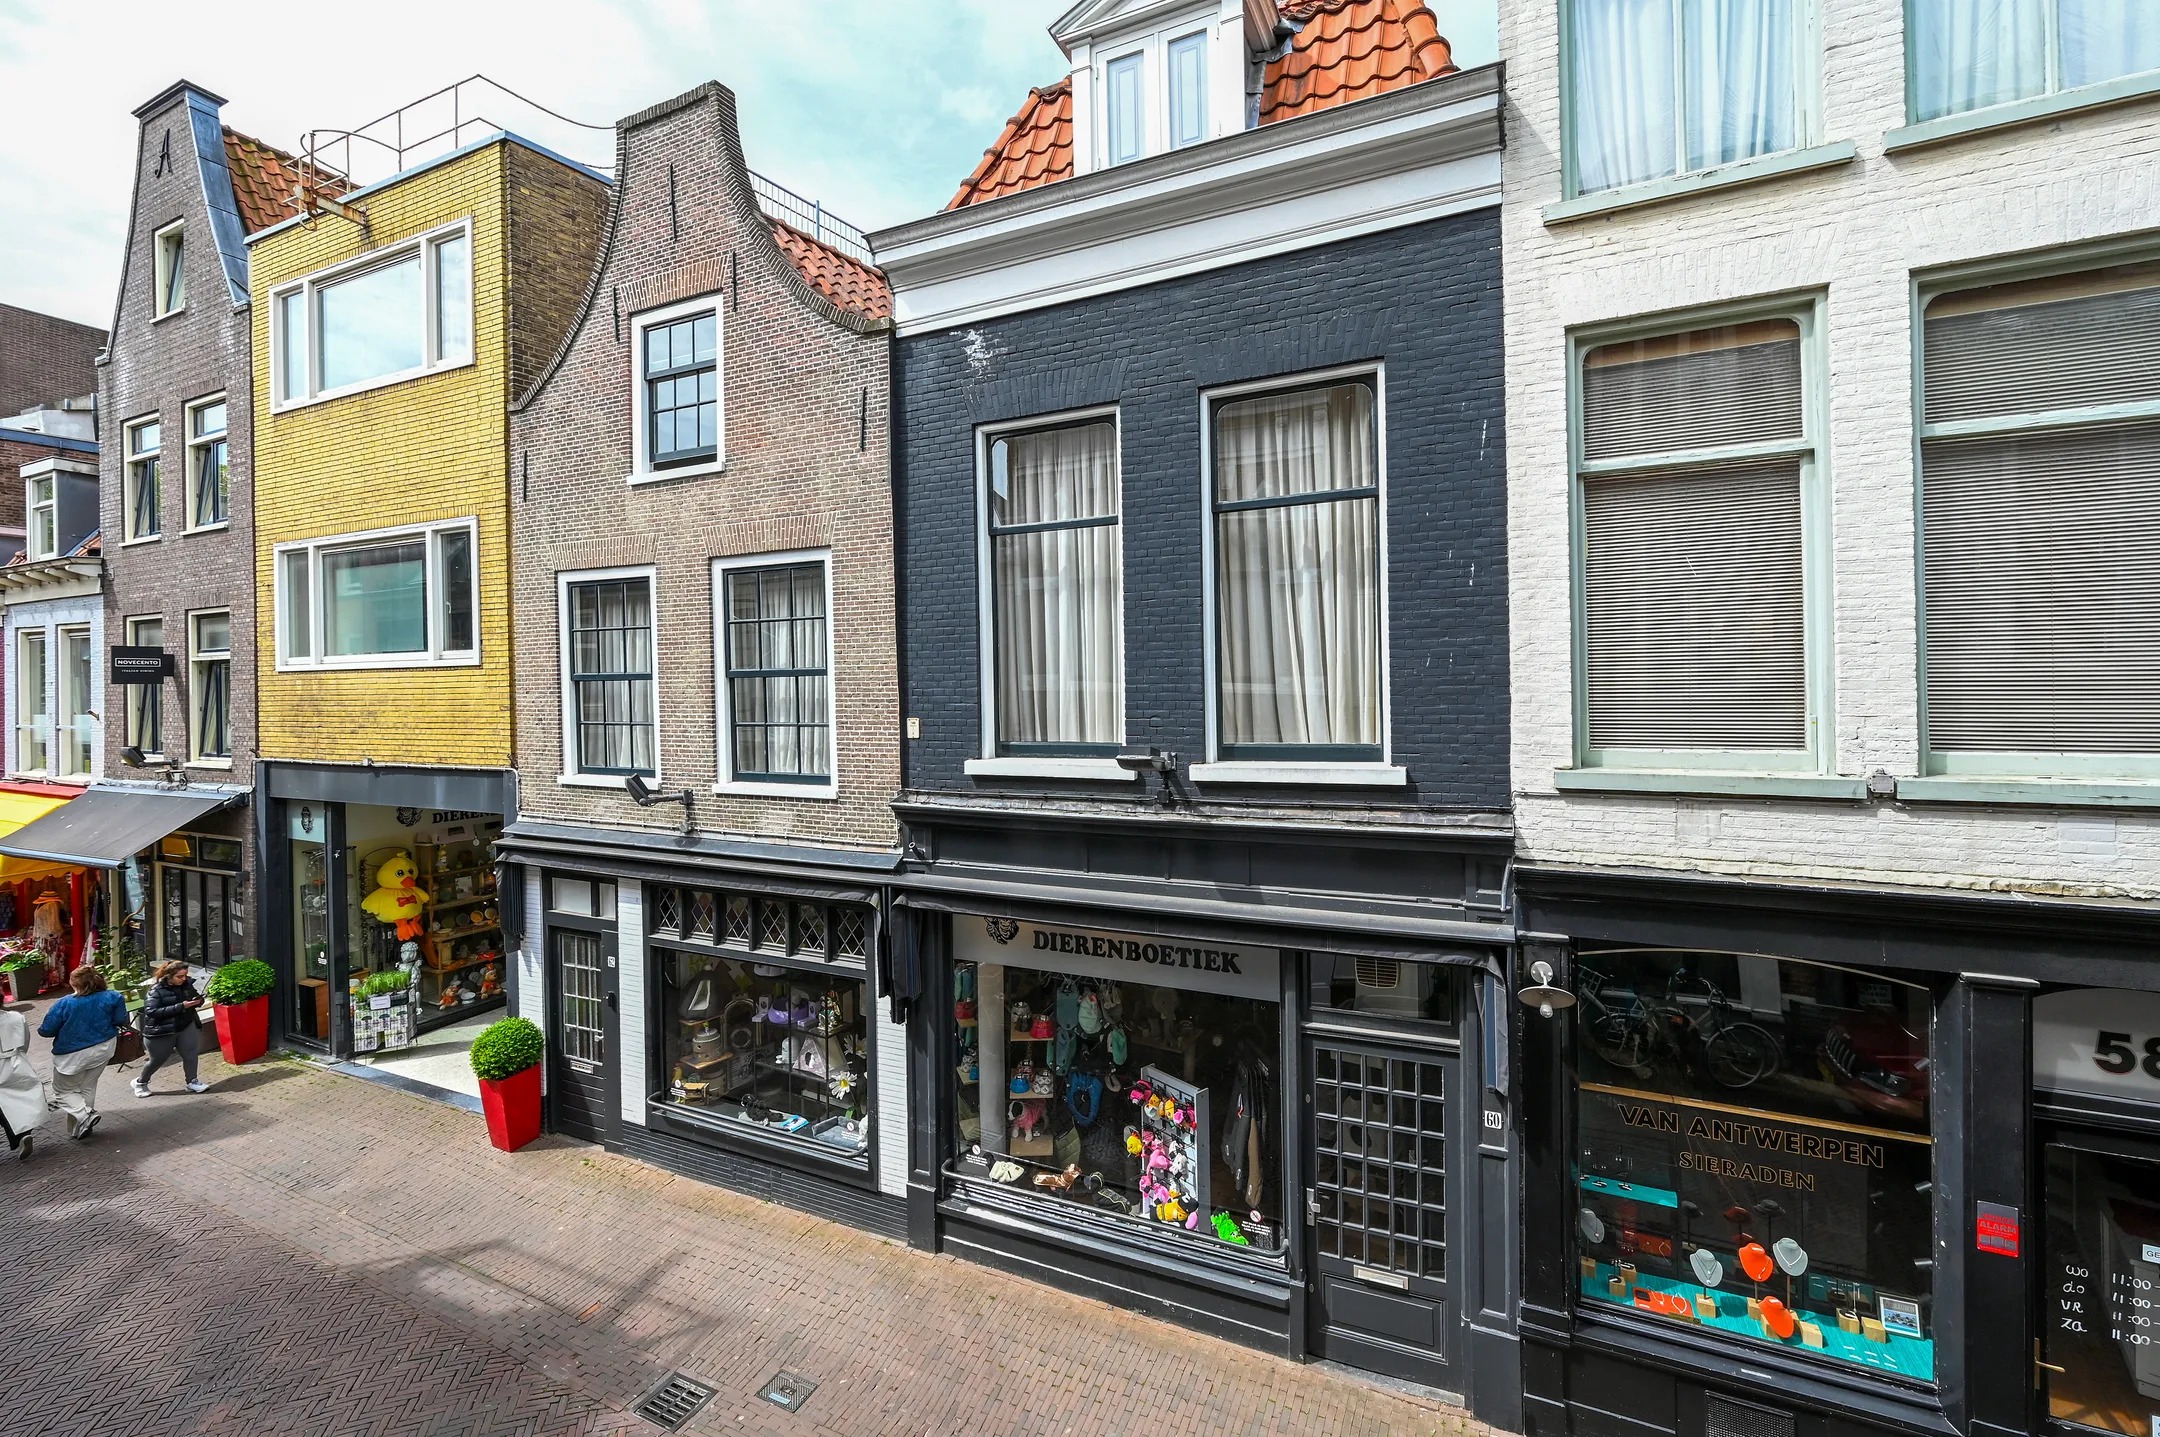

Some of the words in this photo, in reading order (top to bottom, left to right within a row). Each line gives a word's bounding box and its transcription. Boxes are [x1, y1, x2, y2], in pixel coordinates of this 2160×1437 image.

[1033, 930, 1242, 974] DIERENBOETIEK
[1486, 1112, 1500, 1127] 60
[1617, 1103, 1679, 1133] VAN
[1687, 1116, 1884, 1169] ANTWERPEN
[1679, 1151, 1815, 1191] SIERADEN
[1979, 1221, 2017, 1234] ALARM
